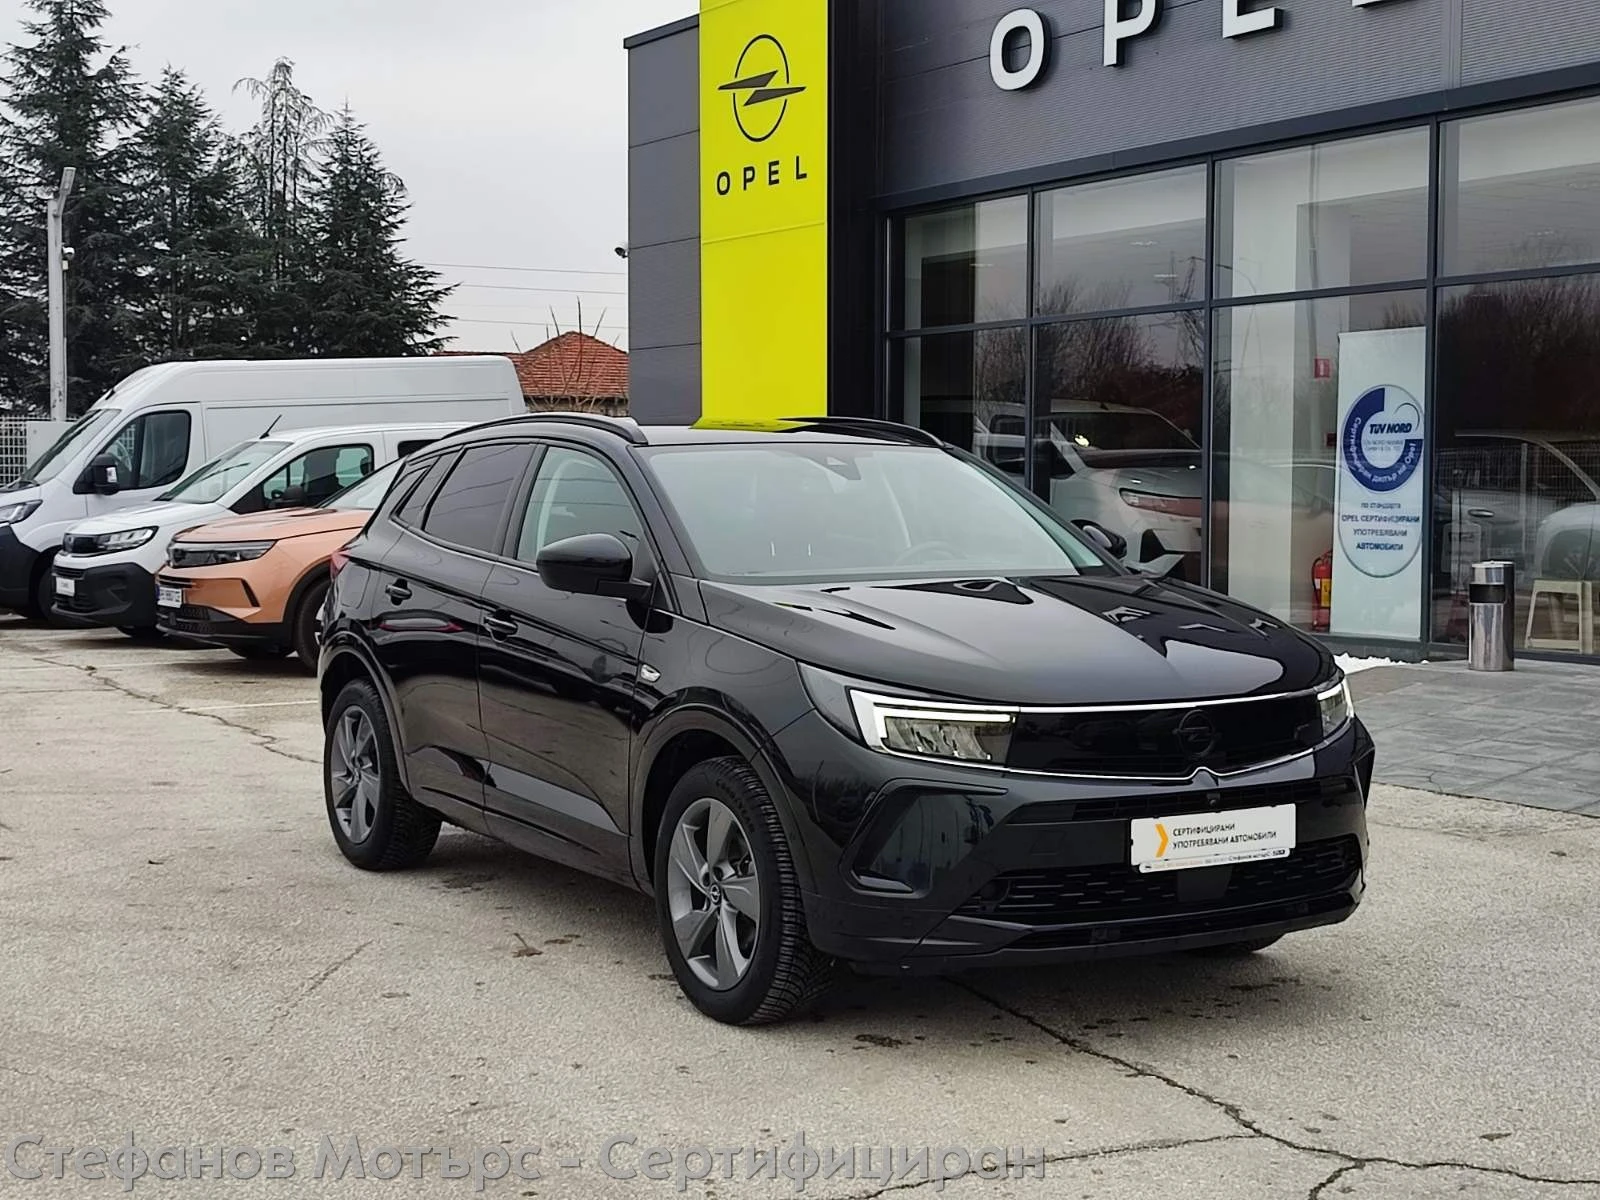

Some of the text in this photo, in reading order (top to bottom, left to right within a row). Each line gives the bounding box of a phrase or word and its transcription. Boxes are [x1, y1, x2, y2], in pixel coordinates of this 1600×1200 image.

[989, 0, 1378, 91] OP
[717, 156, 807, 195] OPEL
[1386, 423, 1412, 434] NORD
[1405, 443, 1417, 464] Opel
[1342, 514, 1359, 522] OPEL
[1173, 823, 1236, 837] СЕРТИФИЦИРАНИ
[1173, 831, 1277, 849] УПОТРЕБЯВАНИ АВТОМОБИЛИ
